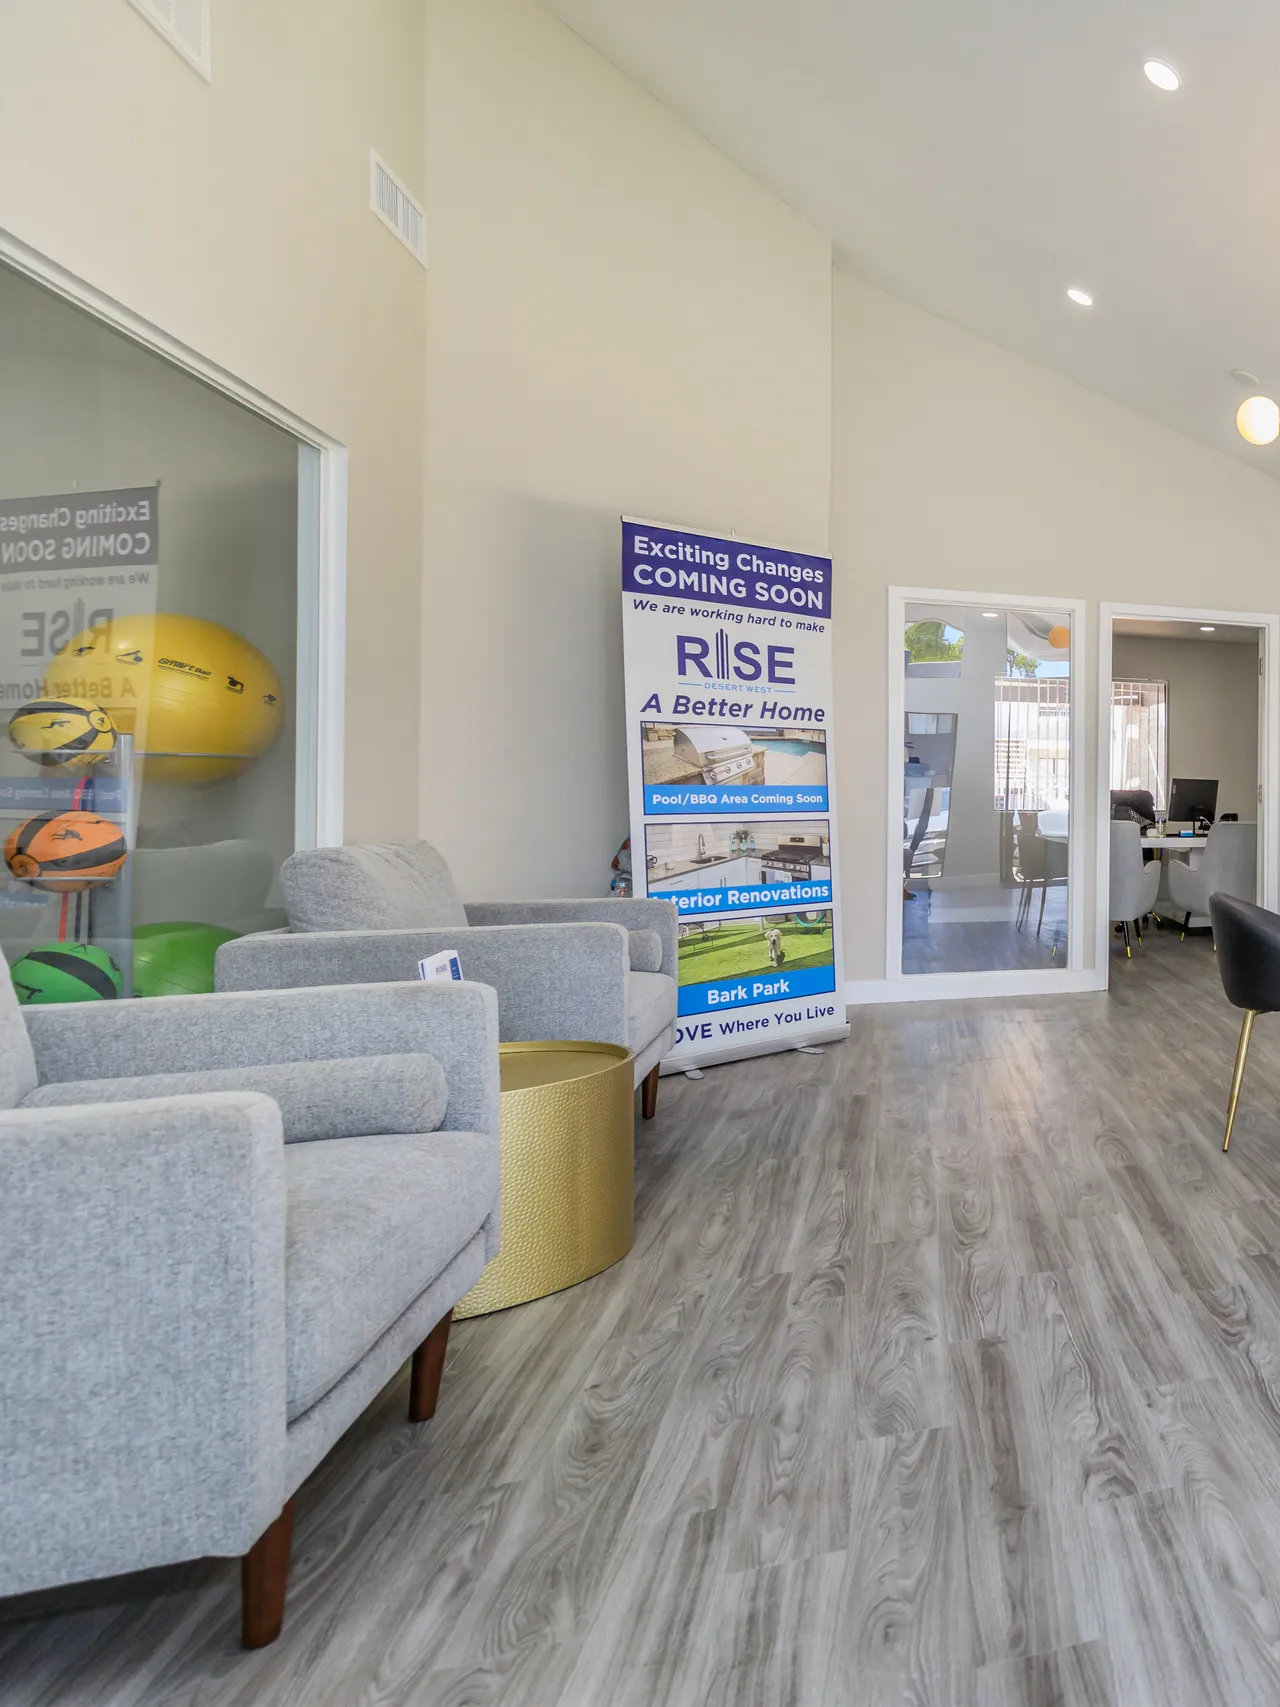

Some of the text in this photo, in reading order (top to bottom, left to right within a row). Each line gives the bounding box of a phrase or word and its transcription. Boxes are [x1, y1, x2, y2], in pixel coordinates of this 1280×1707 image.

[634, 535, 824, 583] Exciting Changes
[633, 564, 823, 610] COMING SOON
[633, 599, 825, 633] We are working hard to make
[676, 628, 796, 685] RISE
[704, 682, 772, 694] DESERT WEST
[640, 693, 825, 722] A Better Home
[652, 793, 823, 806] Pool/BBQ Area Coming Soon
[653, 884, 829, 910] terior Renovations
[707, 979, 790, 1005] Bark Park
[675, 1005, 835, 1044] OVE Where You Live
